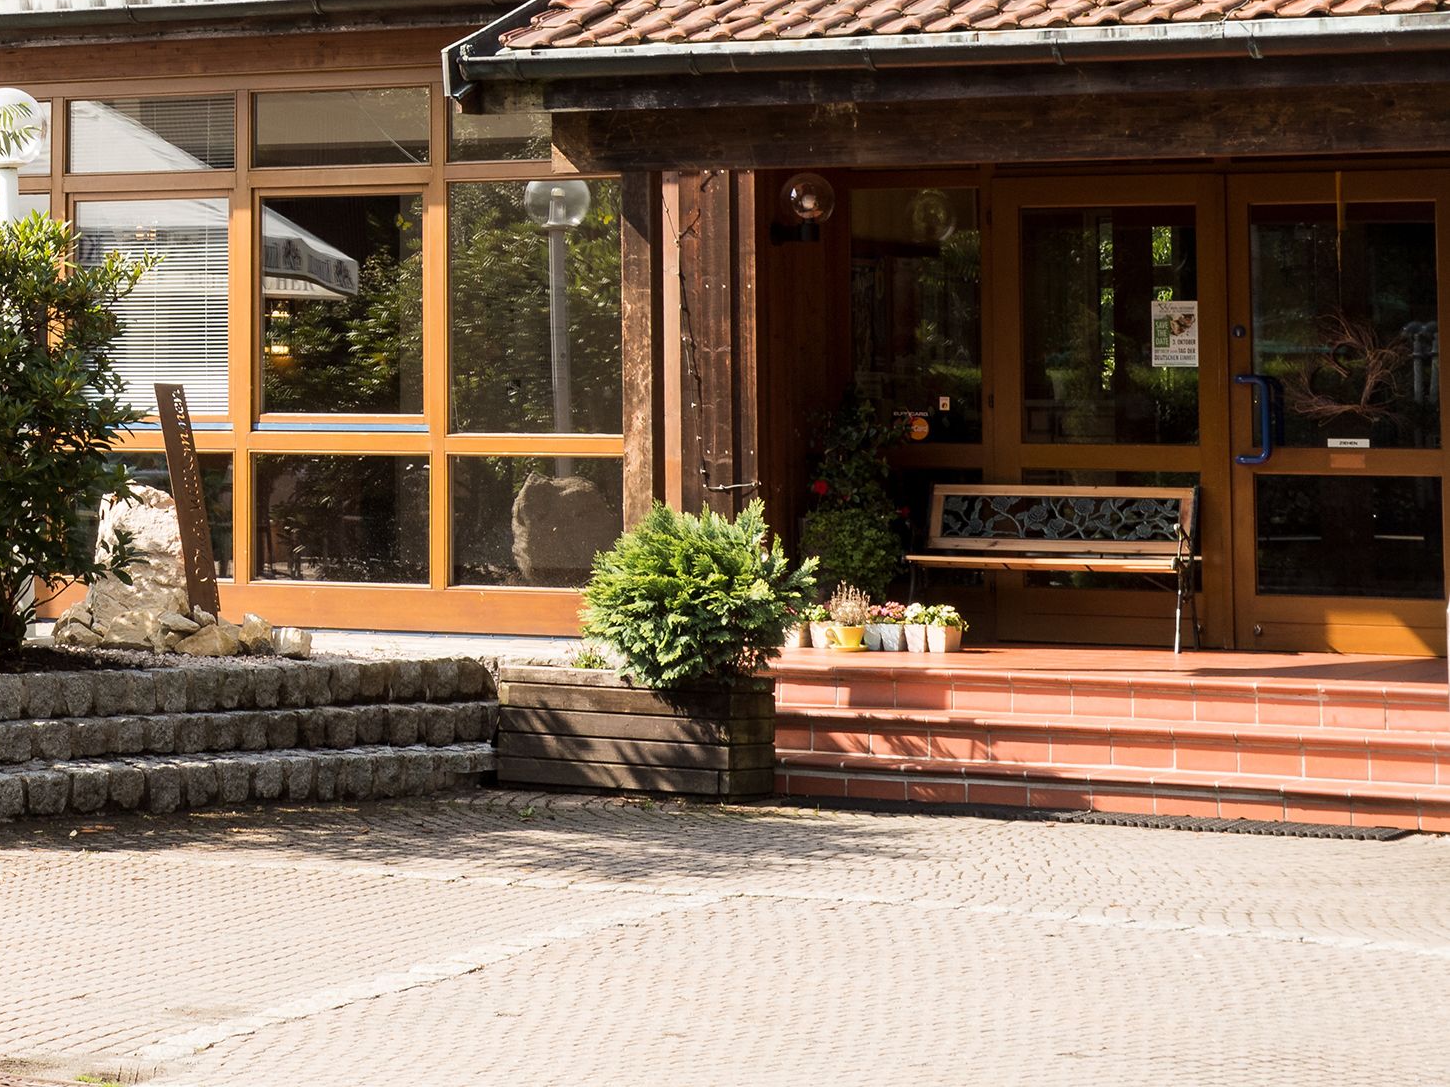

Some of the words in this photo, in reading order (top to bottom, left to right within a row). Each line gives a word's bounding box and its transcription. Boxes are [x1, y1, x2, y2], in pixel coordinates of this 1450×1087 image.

[1155, 321, 1169, 329] SAVE
[1157, 329, 1167, 337] THE
[1155, 337, 1169, 345] DATE
